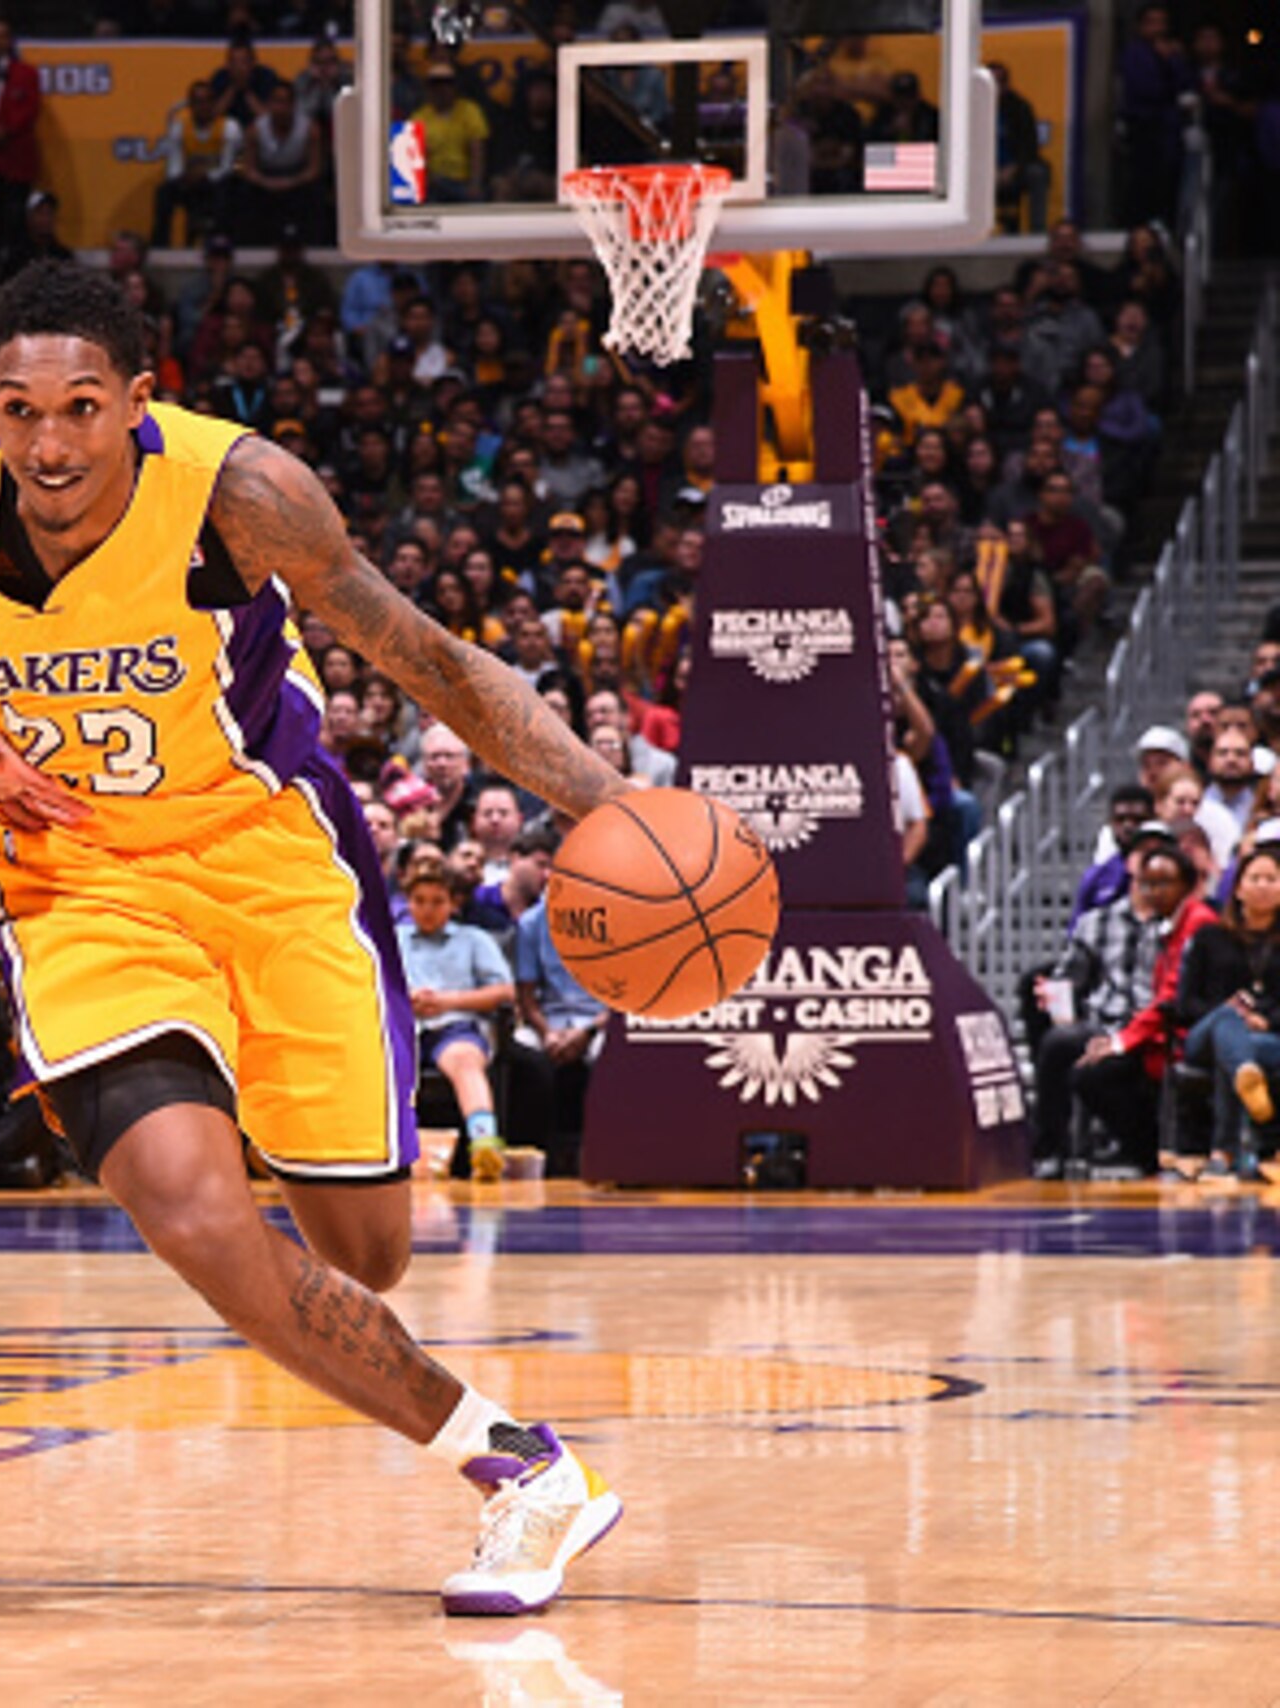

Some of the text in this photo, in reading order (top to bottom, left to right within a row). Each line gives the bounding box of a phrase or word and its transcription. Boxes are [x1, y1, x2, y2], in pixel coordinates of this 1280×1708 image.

[721, 502, 831, 529] SPALDING
[711, 610, 852, 633] PECHANGA
[0, 699, 166, 797] 23
[691, 763, 862, 790] PECHANGA
[786, 793, 863, 811] CASINO
[795, 999, 932, 1029] CASINO
